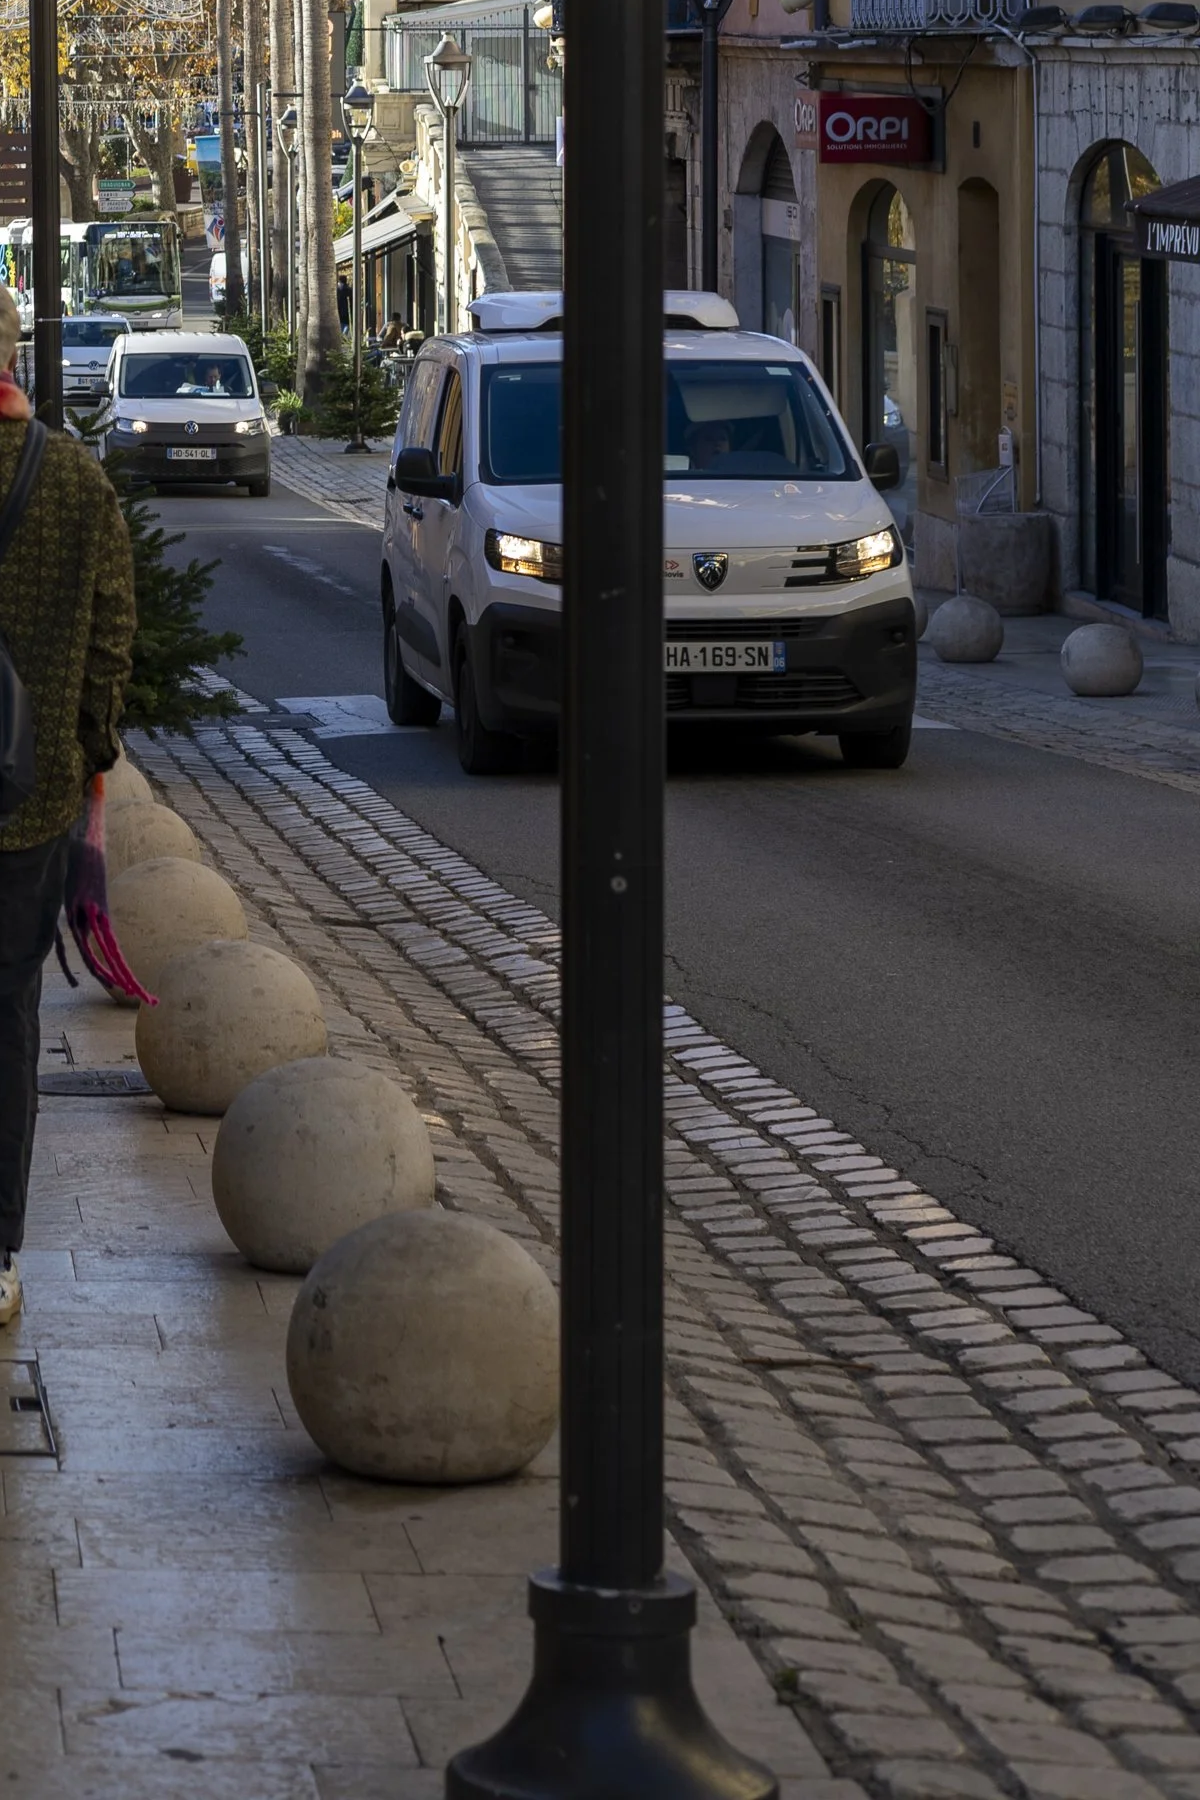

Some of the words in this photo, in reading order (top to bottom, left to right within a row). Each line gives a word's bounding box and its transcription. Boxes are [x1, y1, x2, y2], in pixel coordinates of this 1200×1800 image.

[825, 111, 909, 142] ORPI
[826, 142, 863, 150] SOLUTIONS
[1146, 219, 1199, 256] L'IMPRÉVU
[666, 646, 769, 667] HA-169-SN
